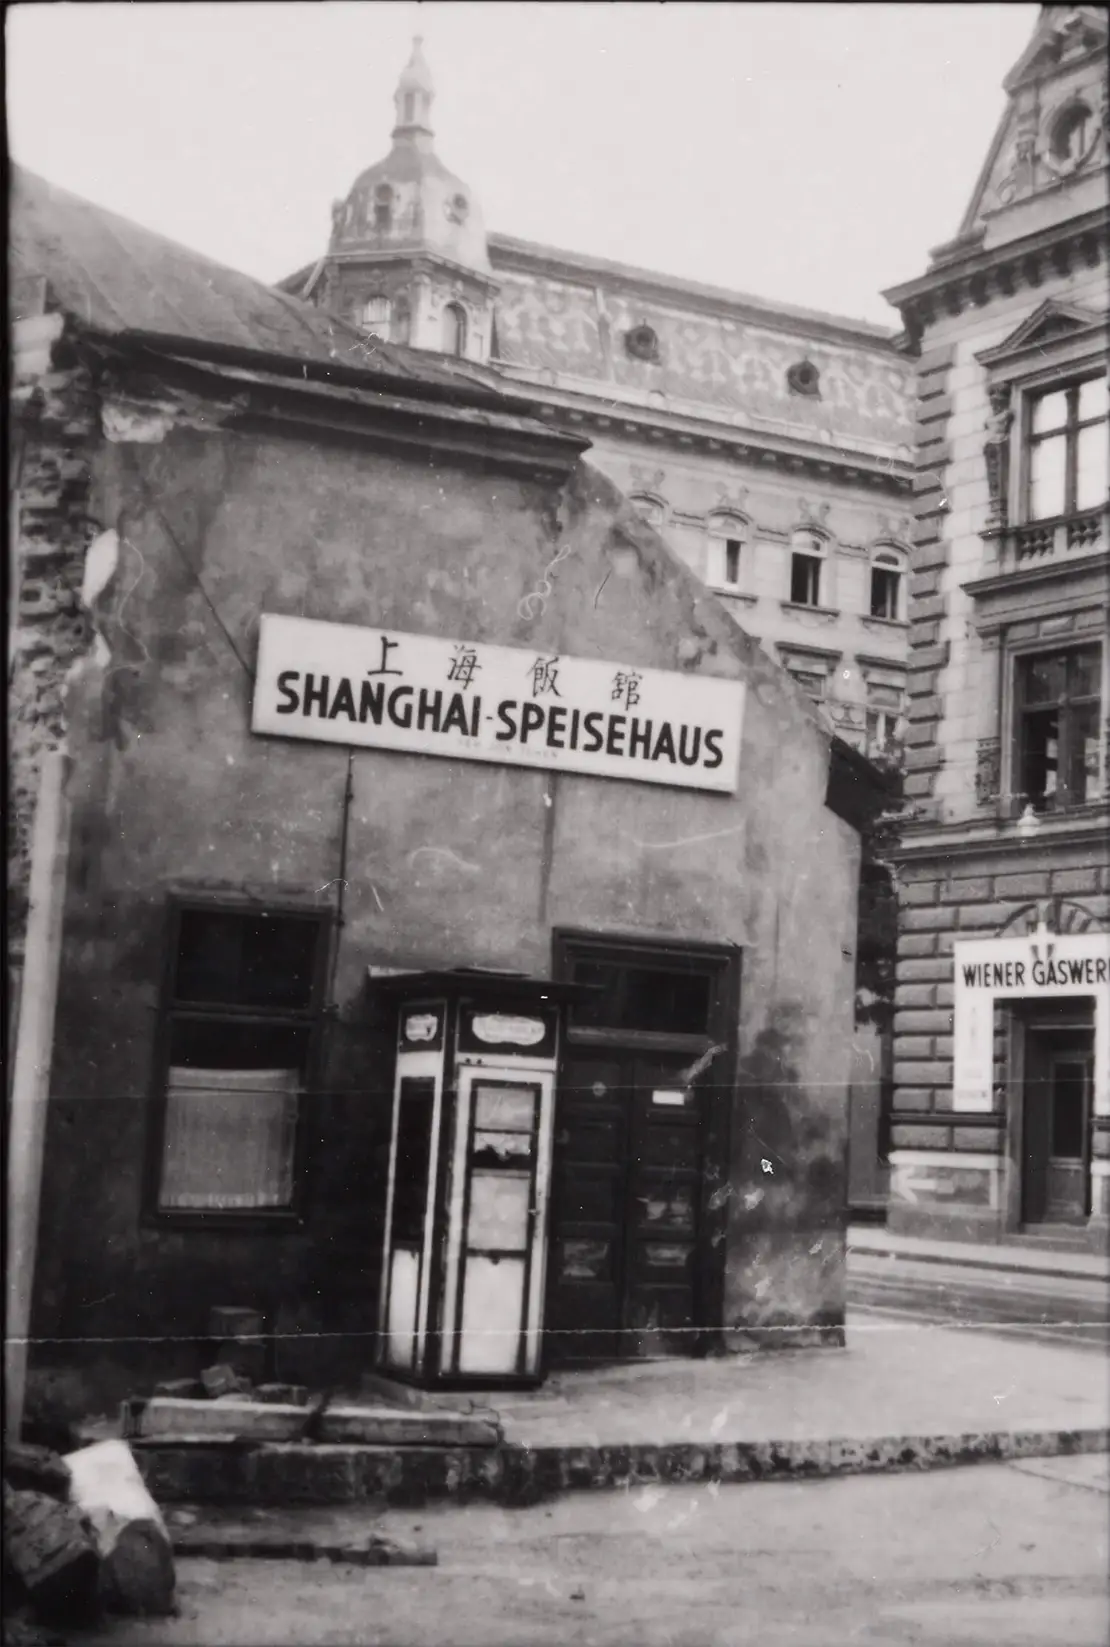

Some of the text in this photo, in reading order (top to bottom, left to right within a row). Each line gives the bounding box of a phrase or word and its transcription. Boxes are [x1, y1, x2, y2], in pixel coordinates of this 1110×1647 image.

[275, 671, 724, 768] SHANGHAI-SPEISEHAUS
[963, 958, 1110, 987] WIENER GASWER
